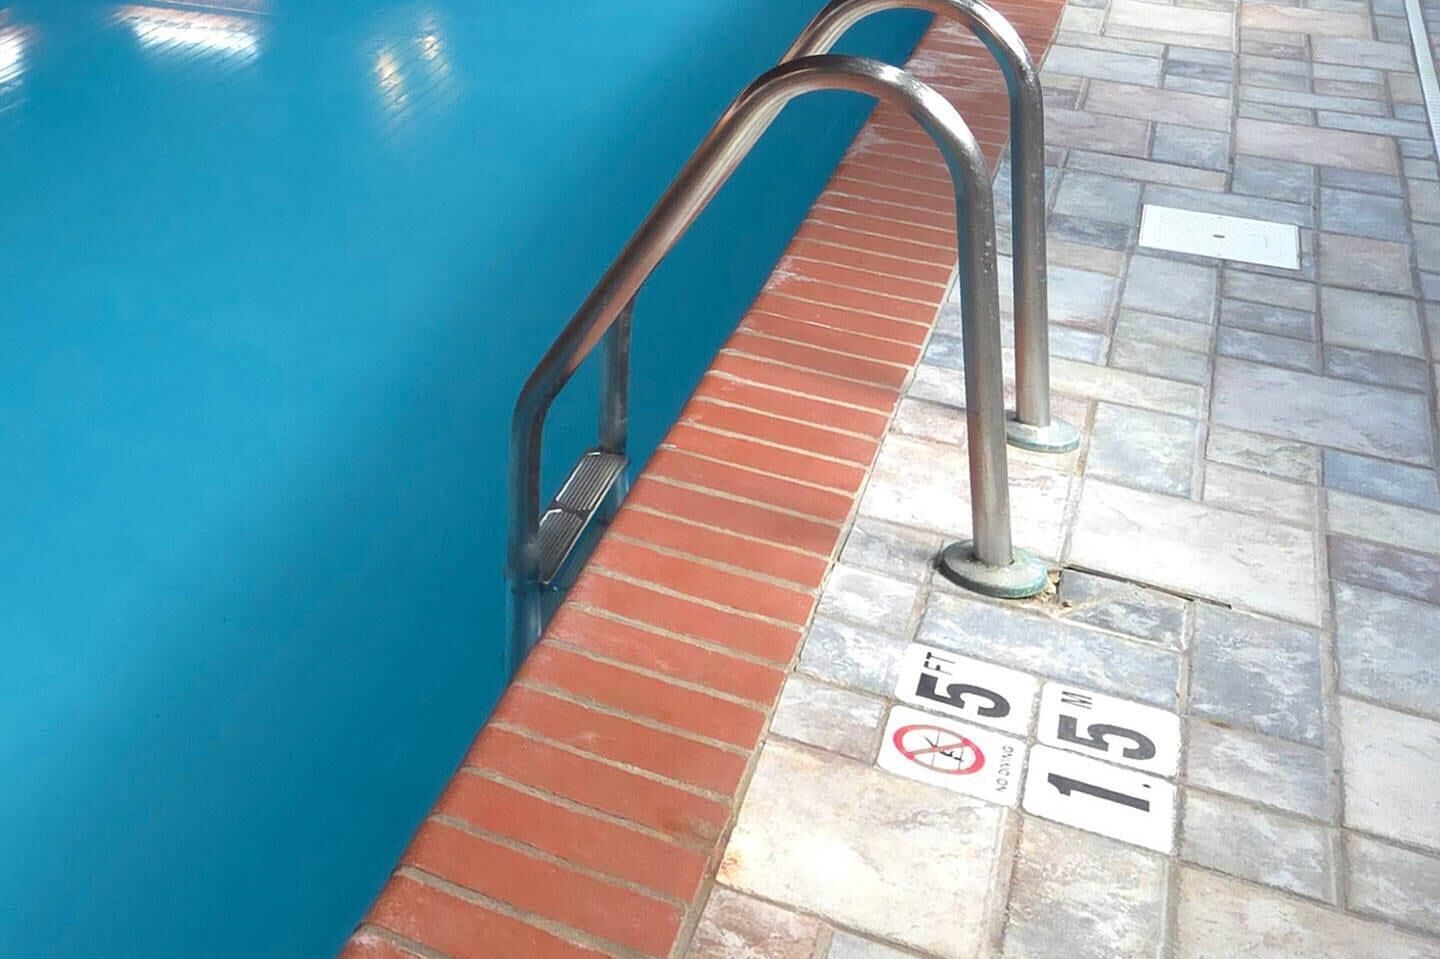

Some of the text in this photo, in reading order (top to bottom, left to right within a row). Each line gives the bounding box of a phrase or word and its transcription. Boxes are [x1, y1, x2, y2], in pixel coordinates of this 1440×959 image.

[916, 651, 1011, 719] 5 FT
[1061, 690, 1092, 709] M
[995, 745, 1014, 792] NO DIVING
